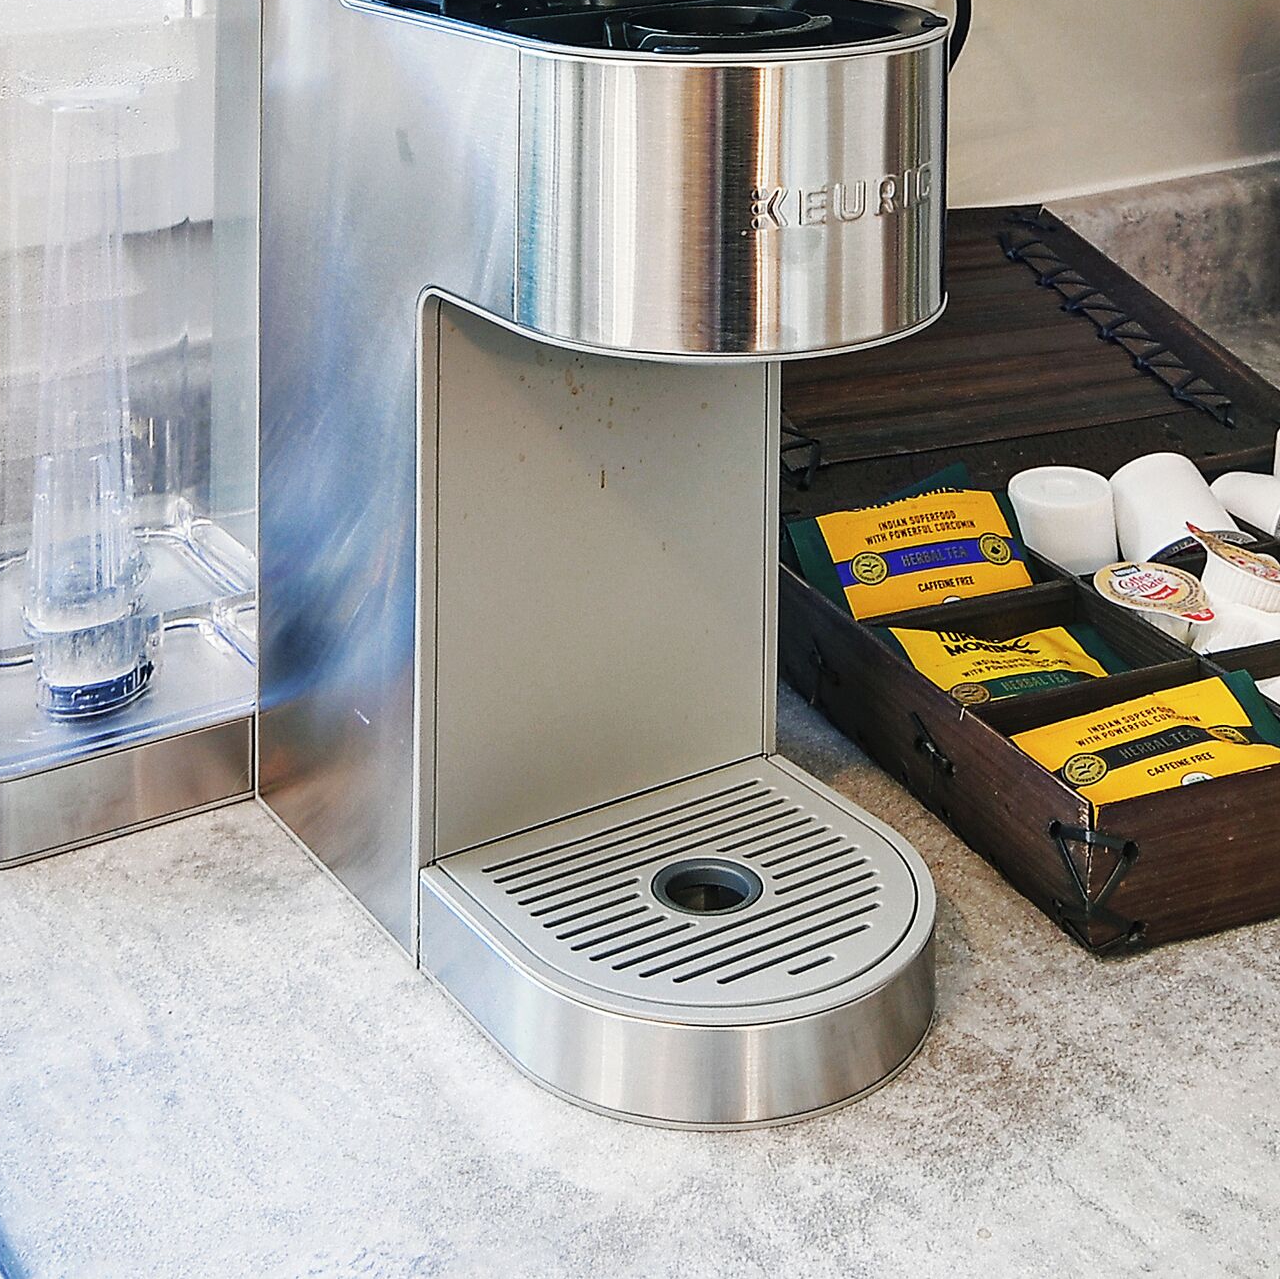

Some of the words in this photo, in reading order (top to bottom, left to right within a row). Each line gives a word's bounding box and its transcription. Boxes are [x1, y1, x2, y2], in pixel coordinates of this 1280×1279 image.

[878, 515, 908, 532] INDIAN
[909, 509, 957, 525] SUPERFOOD
[865, 529, 888, 546] WITH
[889, 525, 934, 541] POWERFUL
[934, 520, 976, 534] CURCUMIN
[901, 548, 946, 568] HERBAL
[946, 545, 969, 562] TEA
[917, 578, 955, 593] CAFFEINE
[955, 575, 975, 587] FREE
[1118, 572, 1152, 590] Coffee
[1000, 674, 1048, 691] HERBAL
[1046, 672, 1071, 684] TEA
[1087, 717, 1122, 734] INDIAN
[1123, 706, 1177, 724] SUPERFOOD
[1075, 733, 1101, 747] WITH
[1102, 718, 1153, 740] POWERFUL
[1119, 738, 1170, 760] HERBAL
[1169, 729, 1200, 745] TEA
[1146, 757, 1190, 777] CAFFEINE
[1190, 751, 1216, 765] FREE
